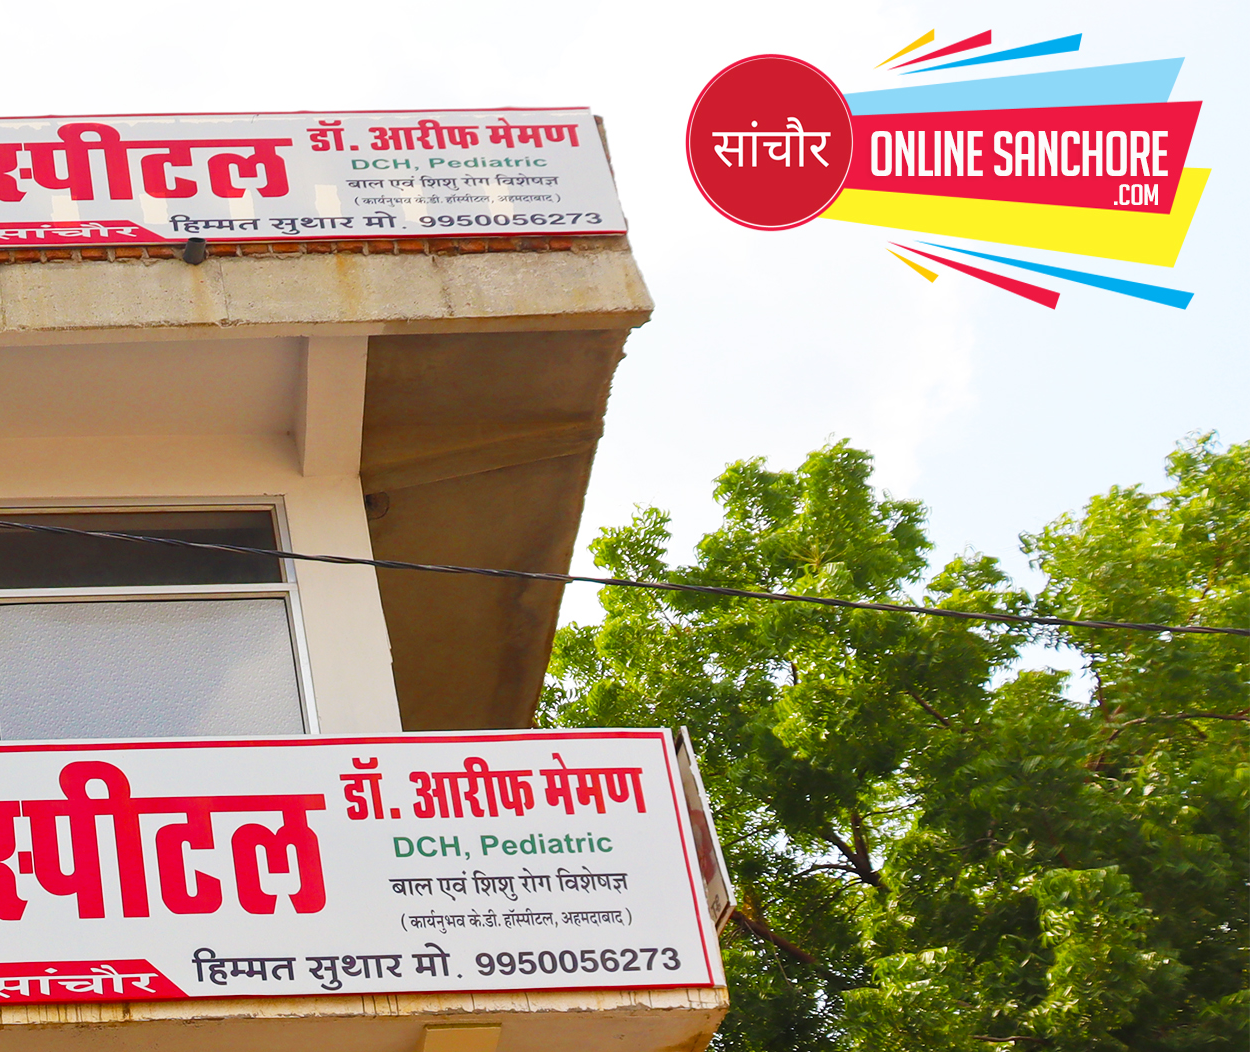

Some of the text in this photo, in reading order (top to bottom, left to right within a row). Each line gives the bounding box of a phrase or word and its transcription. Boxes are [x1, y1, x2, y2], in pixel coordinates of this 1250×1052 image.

[307, 118, 579, 151] डॉ. आरीफ मेमण
[352, 158, 546, 169] DCH, Pediatric
[346, 180, 384, 188] बाल
[389, 176, 414, 190] एवं
[420, 176, 459, 190] शिशु
[461, 174, 489, 185] रोग
[169, 211, 603, 234] हिम्मत सुथार मो. 9950056273
[340, 753, 646, 820] डॉ. आरीफ मेमण
[393, 833, 613, 859] DCH, Pediatric
[389, 878, 433, 896] बाल
[436, 871, 467, 900] एवं
[471, 870, 517, 901] शिशु
[516, 868, 551, 892] रोग
[192, 943, 680, 991] हिम्मत सुथार मो. 9950056273
